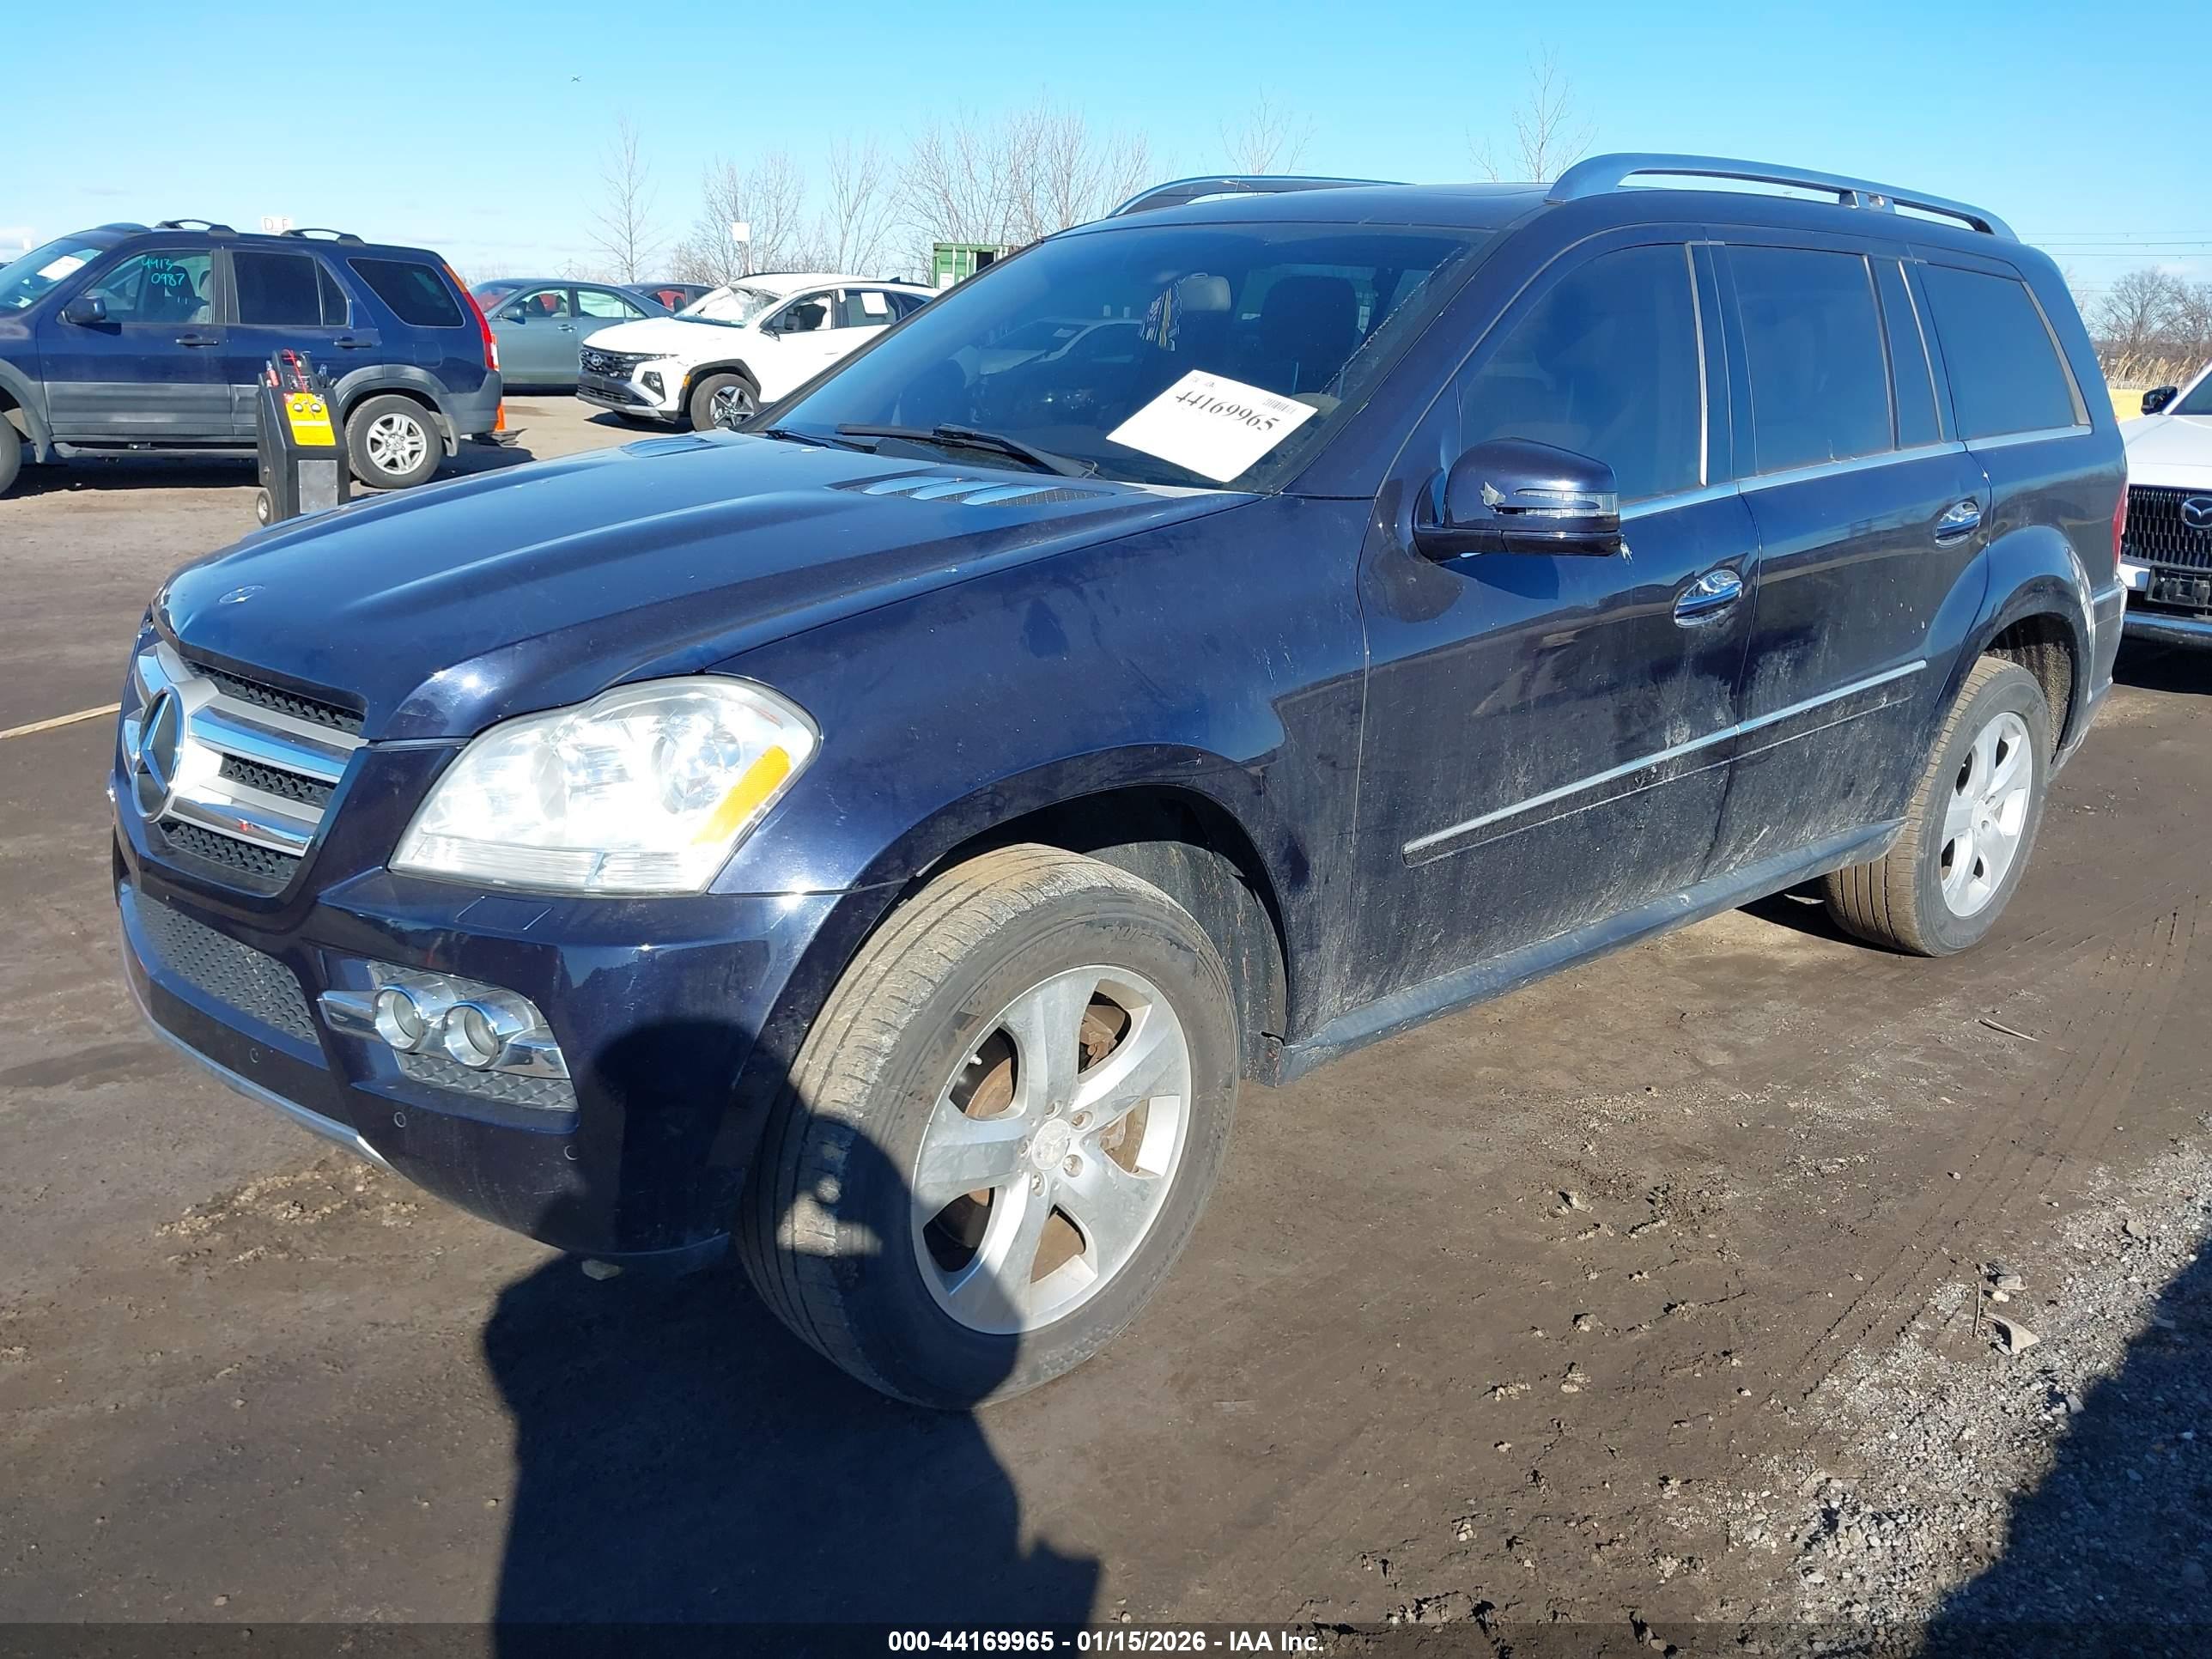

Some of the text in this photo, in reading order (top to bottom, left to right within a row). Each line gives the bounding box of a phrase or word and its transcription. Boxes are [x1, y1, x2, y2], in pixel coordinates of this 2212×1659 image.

[141, 258, 173, 271] 4413
[150, 272, 185, 287] 0987
[1176, 390, 1281, 431] 44169965
